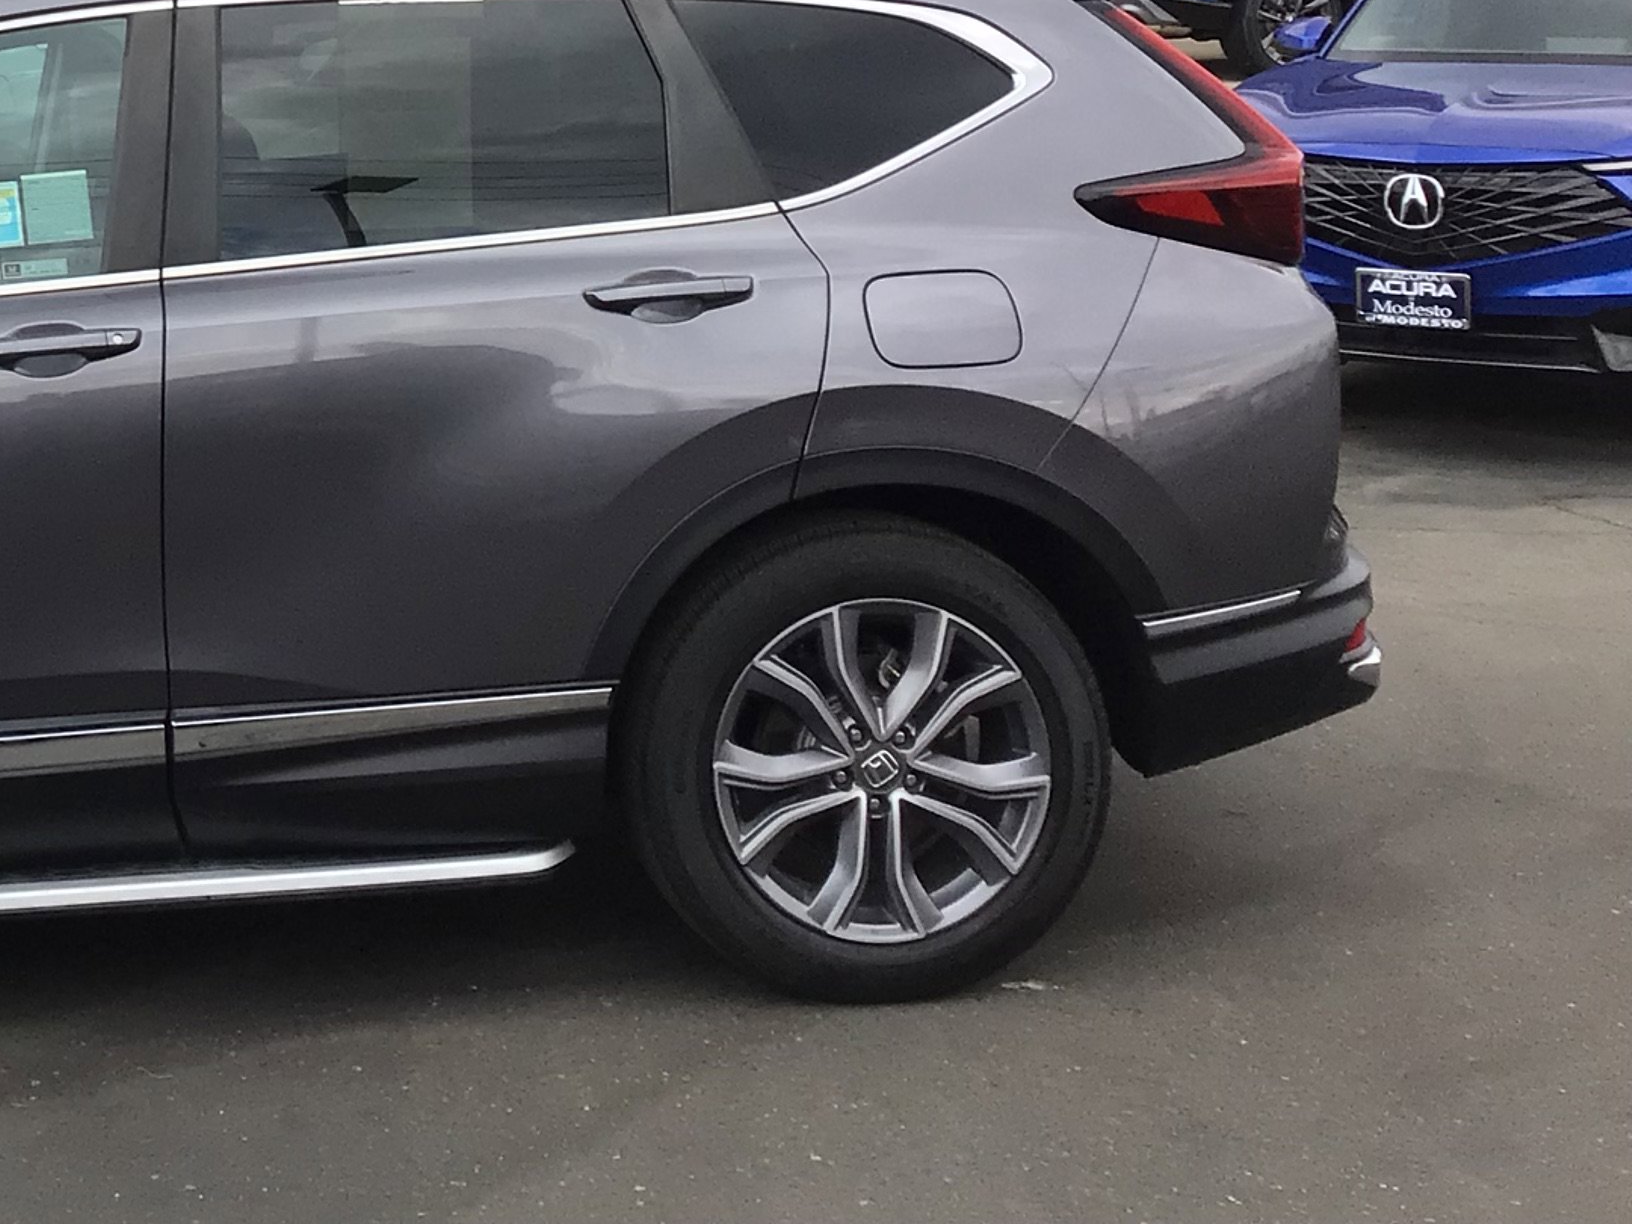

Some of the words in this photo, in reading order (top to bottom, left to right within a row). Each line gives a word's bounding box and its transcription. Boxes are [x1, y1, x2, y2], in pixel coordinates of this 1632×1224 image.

[1368, 278, 1457, 298] ACURA
[1372, 298, 1453, 318] Modesto
[1382, 315, 1463, 328] MODESTO
